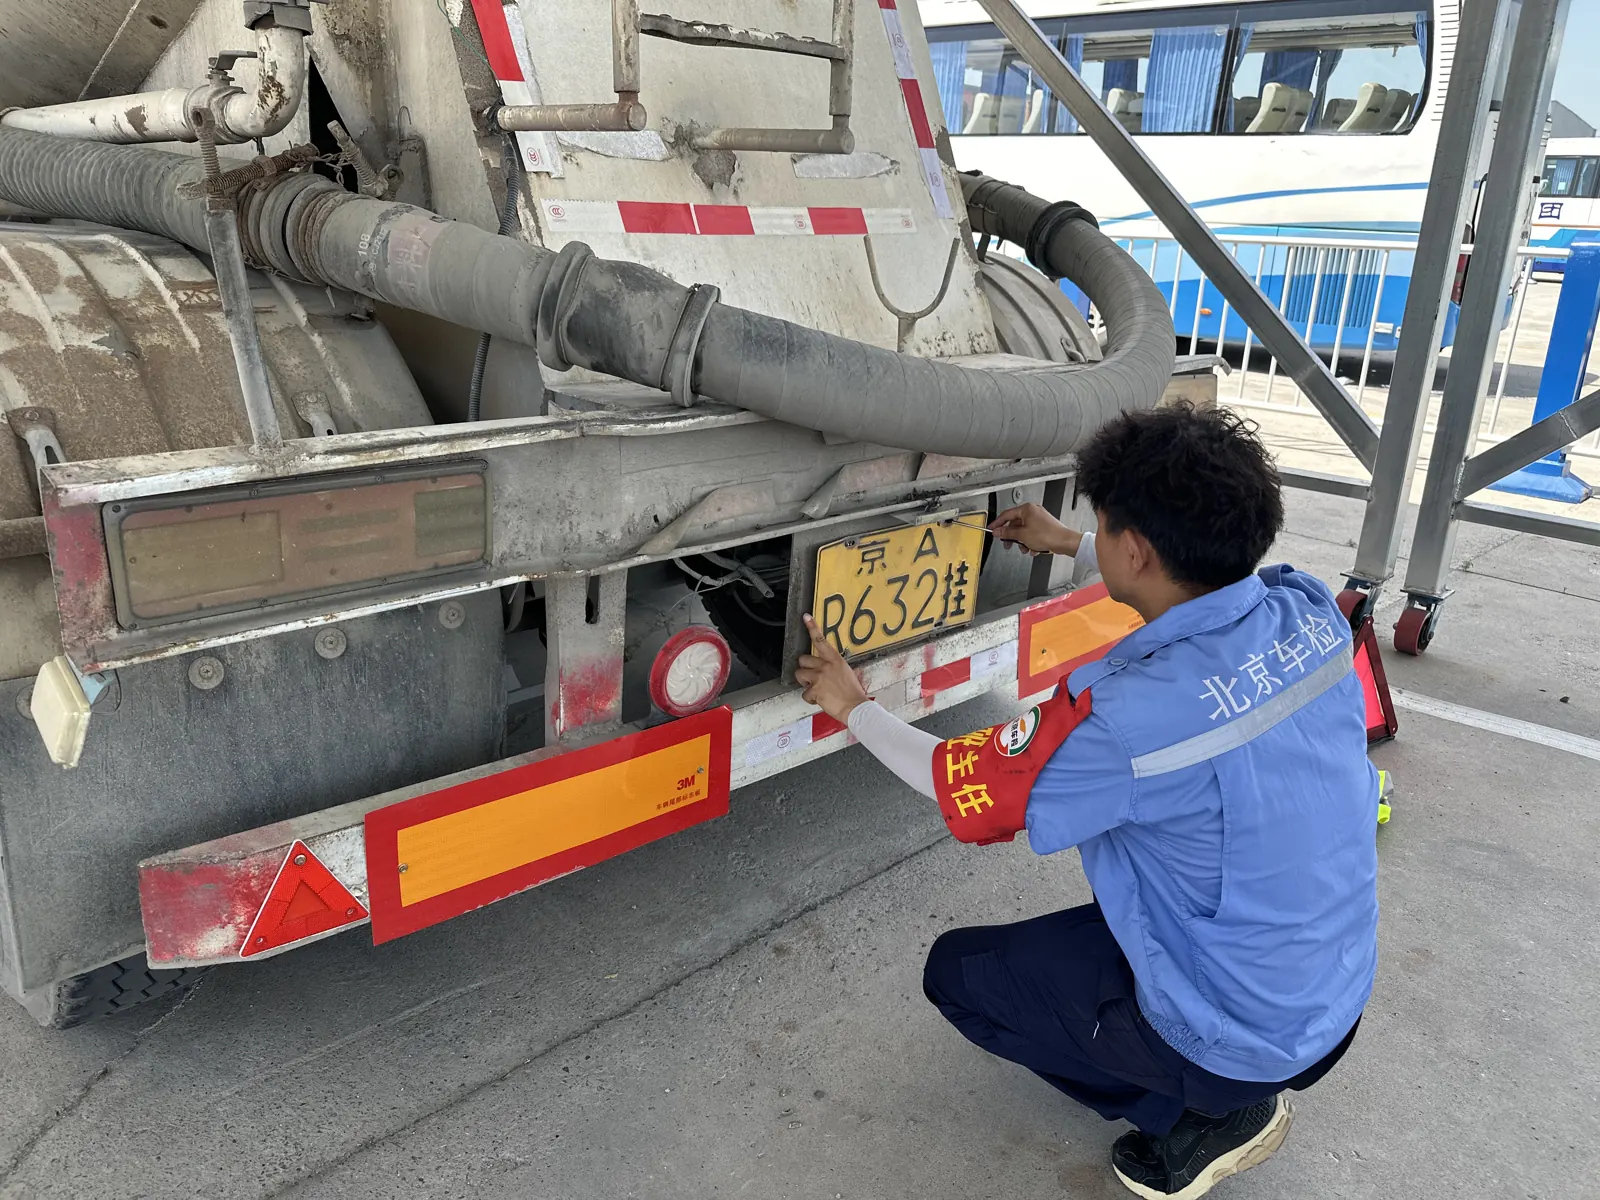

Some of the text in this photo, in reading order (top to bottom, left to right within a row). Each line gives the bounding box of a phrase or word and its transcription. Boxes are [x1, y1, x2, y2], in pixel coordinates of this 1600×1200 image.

[357, 233, 371, 257] 108
[857, 527, 940, 576] 京 A
[822, 559, 969, 654] R632挂
[1198, 613, 1345, 721] 北京车检
[676, 774, 696, 791] 3M
